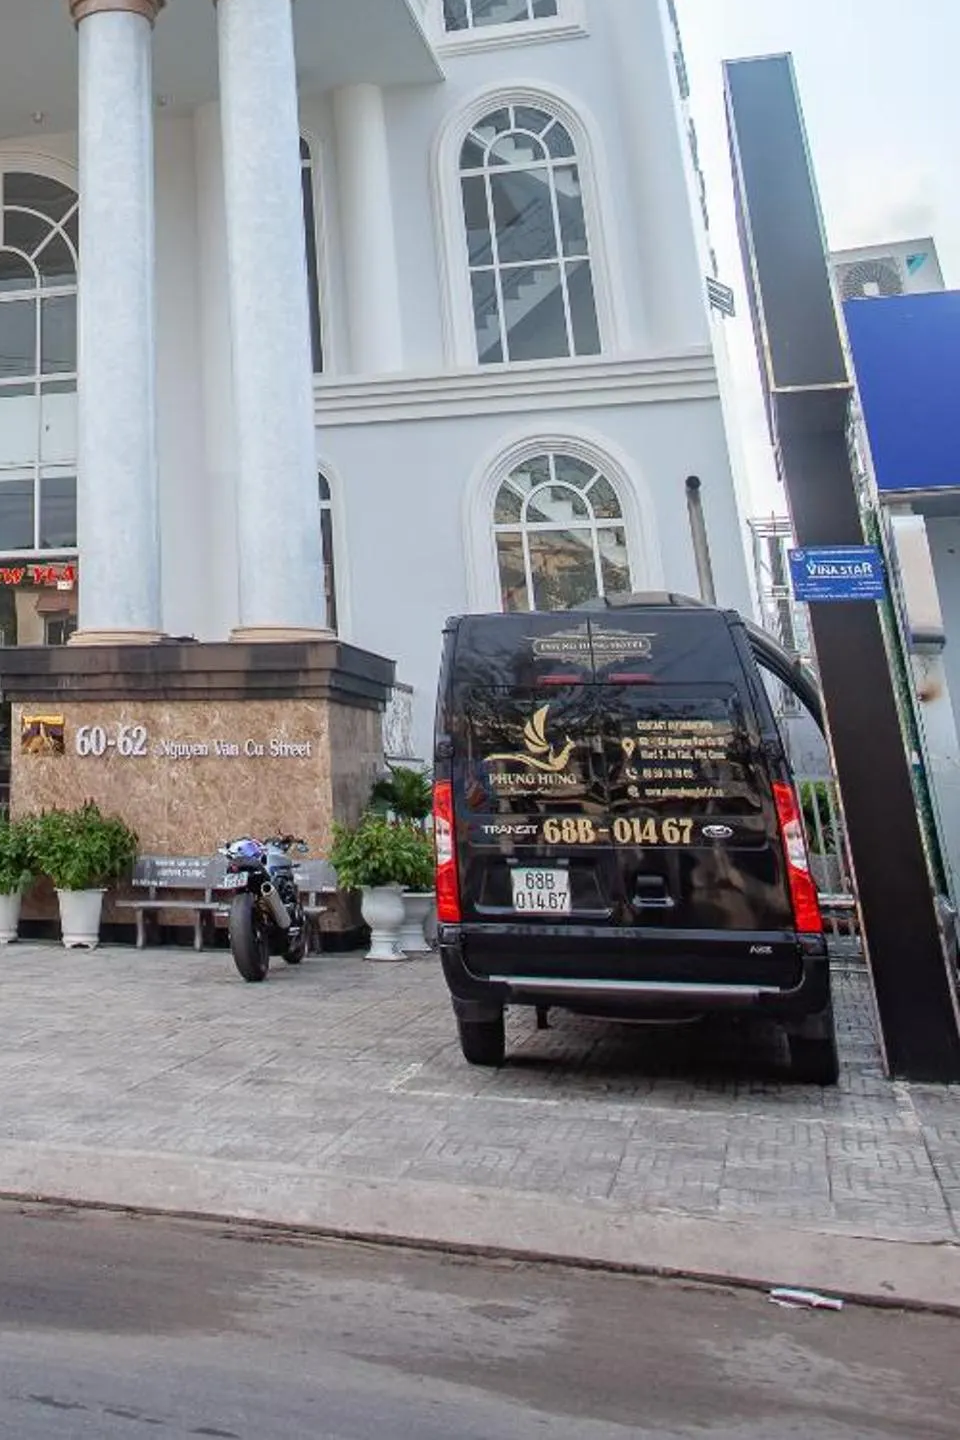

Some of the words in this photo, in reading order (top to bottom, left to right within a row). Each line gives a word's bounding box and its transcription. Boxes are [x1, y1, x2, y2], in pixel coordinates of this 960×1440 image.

[33, 566, 76, 585] YEA
[76, 725, 147, 756] 60-62
[213, 738, 239, 756] Van
[244, 738, 265, 756] Cu
[270, 738, 312, 757] Street
[481, 824, 538, 835] TRANSIT
[542, 817, 596, 844] 68B
[525, 871, 555, 890] 68B
